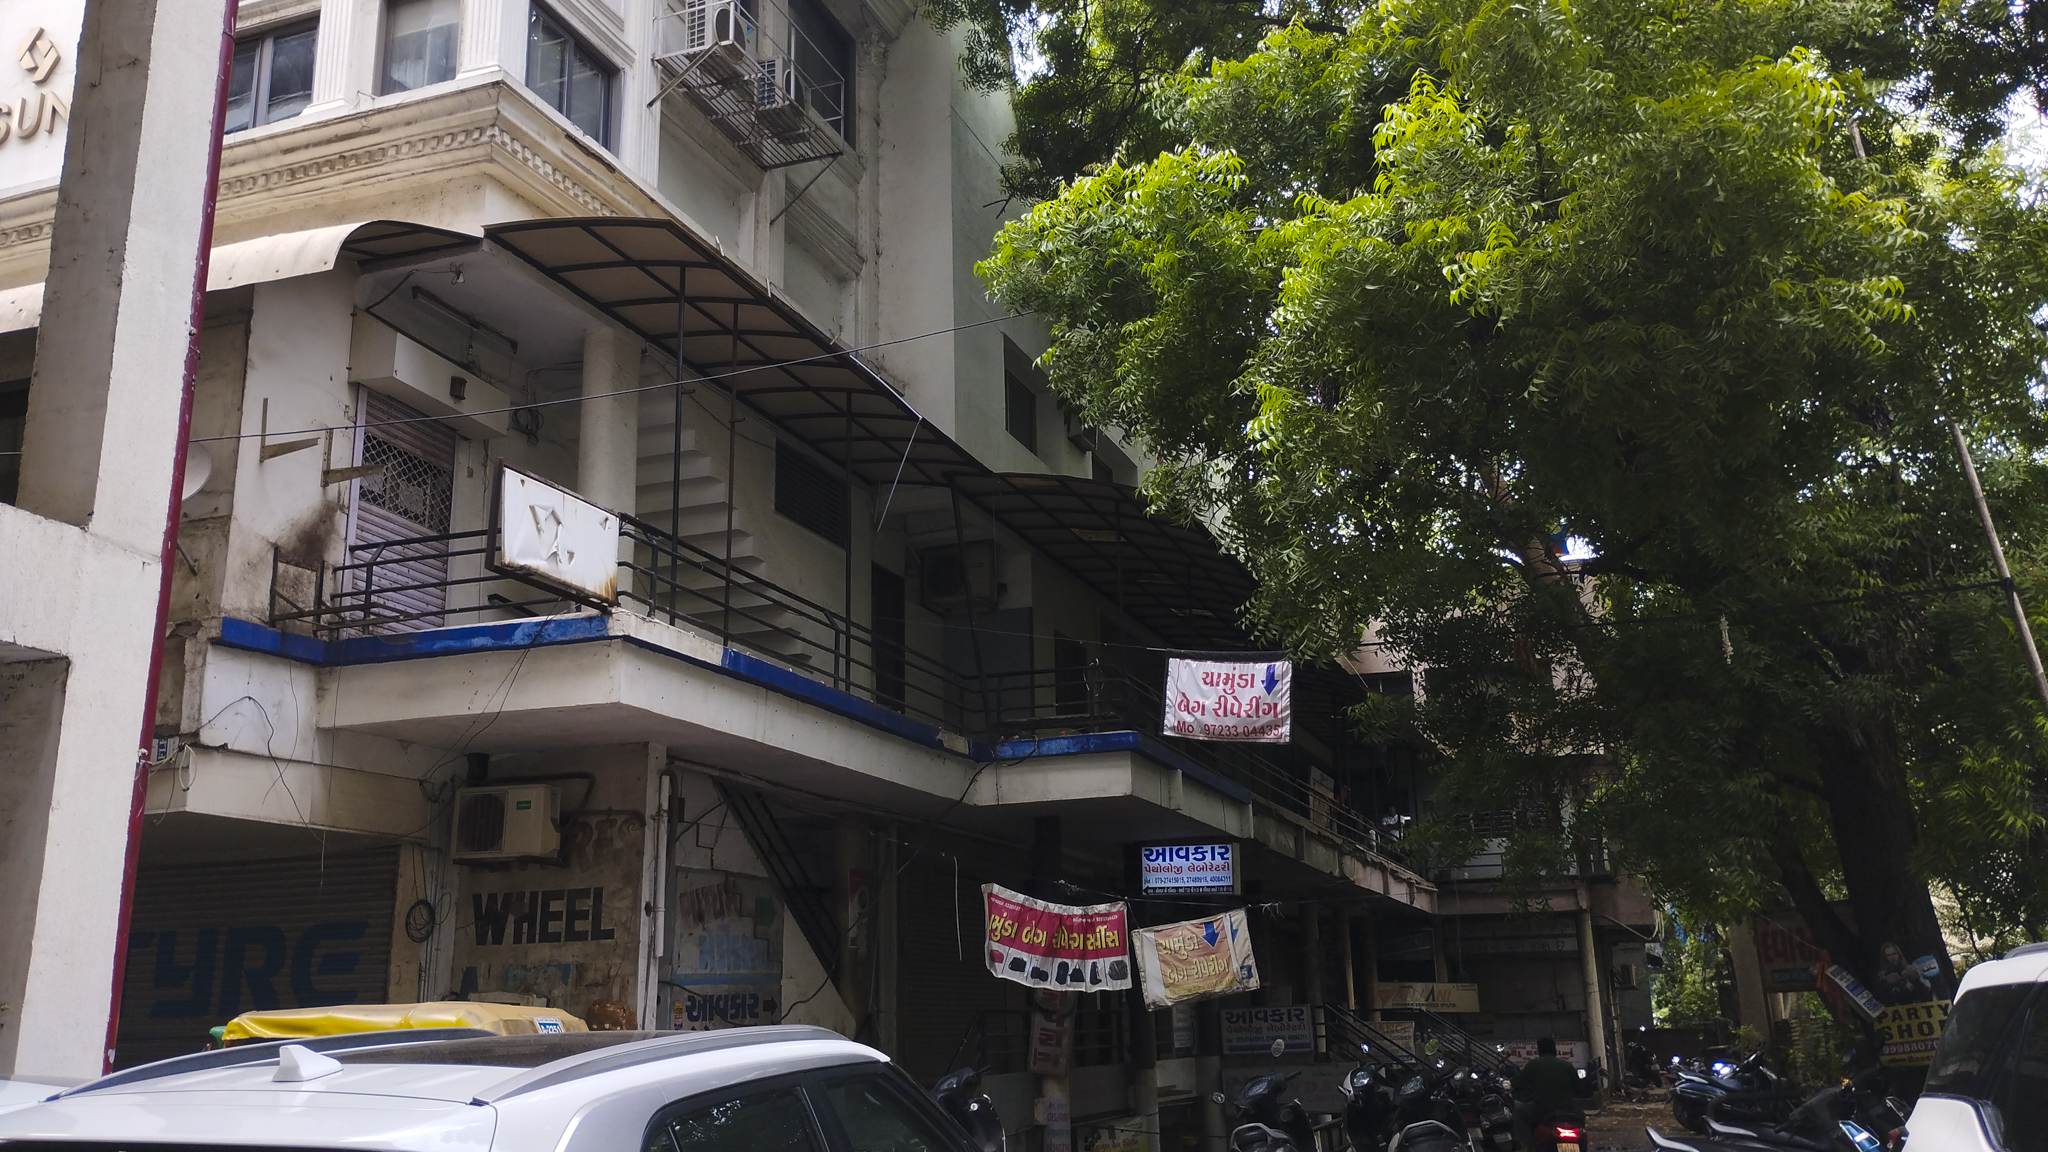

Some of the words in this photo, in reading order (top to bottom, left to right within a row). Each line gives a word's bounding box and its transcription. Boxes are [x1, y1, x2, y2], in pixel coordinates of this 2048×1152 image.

[1201, 666, 1255, 695] ચામુંડા
[1177, 692, 1206, 716] બેગ
[1212, 695, 1278, 718] રીપેરીંગ
[1204, 724, 1239, 738] 97233
[1242, 725, 1281, 738] 04435
[1144, 845, 1230, 863] આવકાર
[1144, 863, 1183, 875] પેથોલોજી
[1187, 861, 1230, 873] લેબોરેટરી
[472, 886, 615, 946] WHEEL
[1021, 920, 1048, 947] બેગ
[1156, 931, 1200, 960] ચામુંડા
[1166, 964, 1189, 984] બેગ
[1225, 1008, 1305, 1024] આવકાર
[1876, 1003, 1950, 1024] PARTY
[1266, 1022, 1306, 1032] લેબોરેટરી
